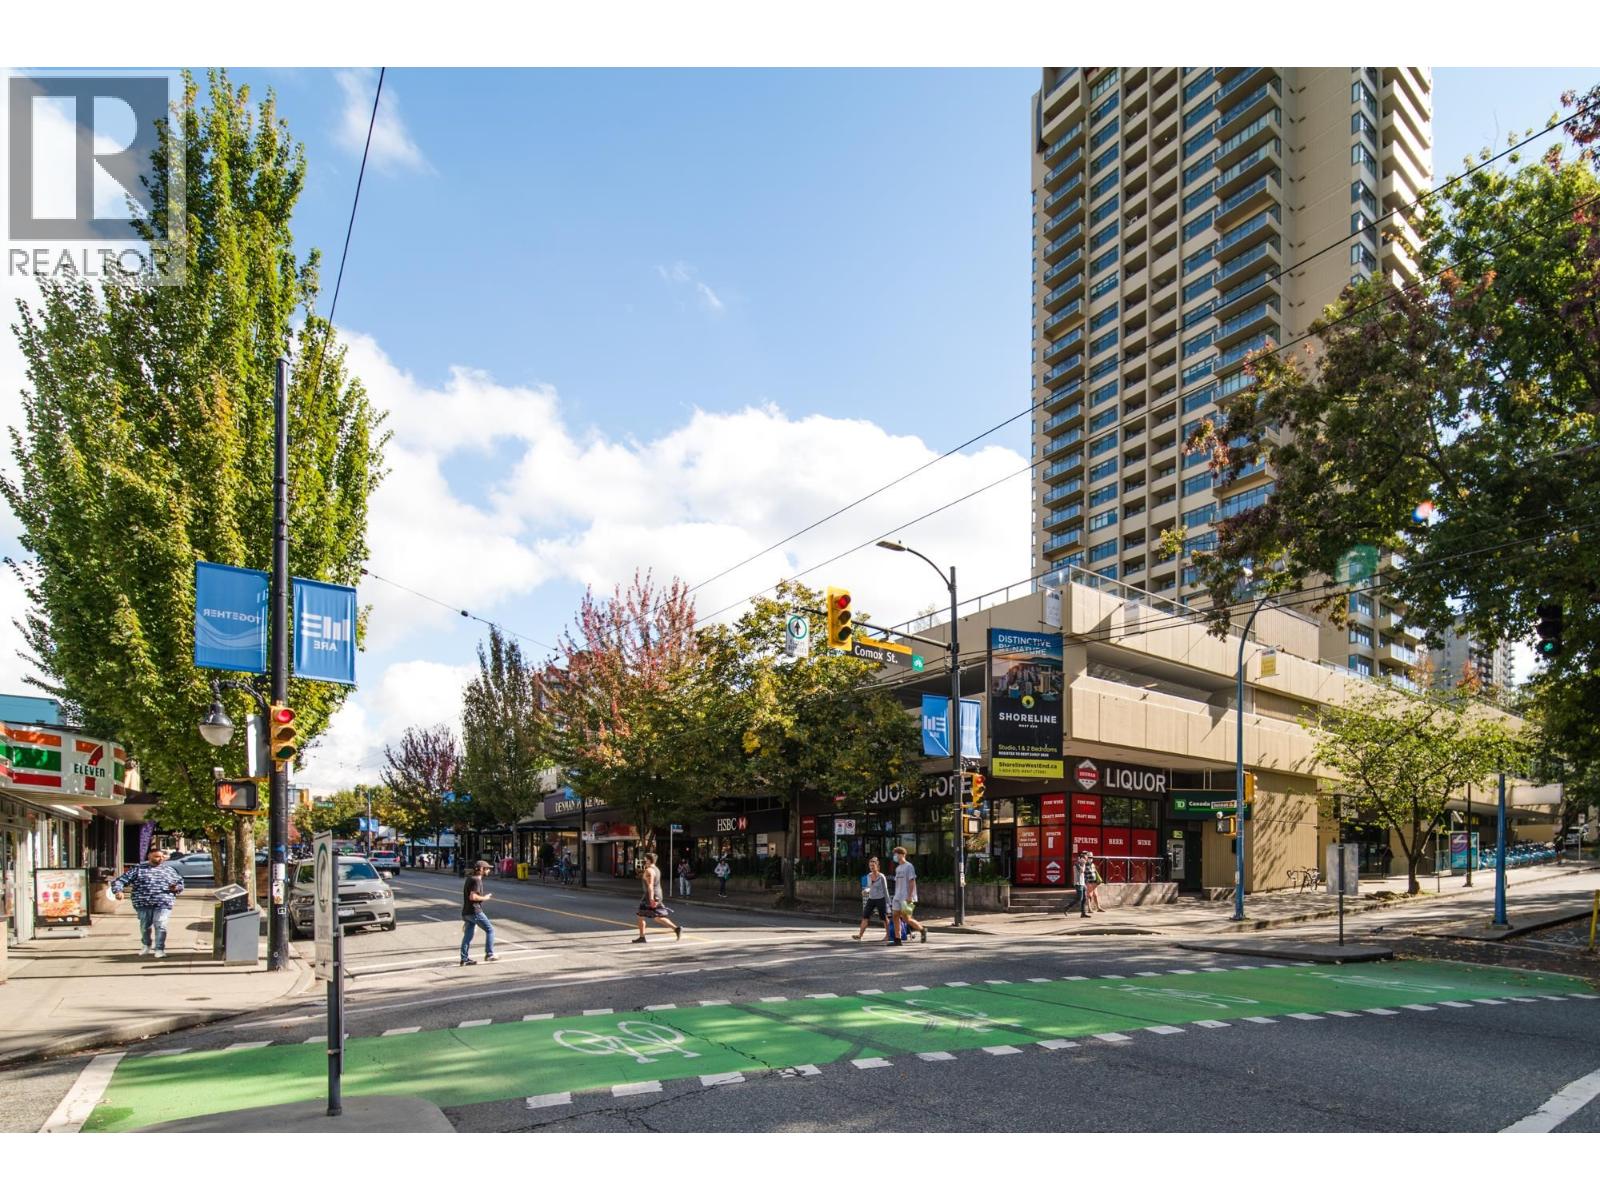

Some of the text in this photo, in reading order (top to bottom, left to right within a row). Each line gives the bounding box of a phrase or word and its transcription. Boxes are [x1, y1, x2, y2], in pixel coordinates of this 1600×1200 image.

[998, 634, 1051, 648] DISTINCTIVE
[854, 645, 899, 664] Comox St.
[998, 711, 1057, 724] SHORELINE
[75, 739, 104, 791] 7
[1106, 767, 1166, 793] LIQUOR
[1176, 800, 1185, 808] TD
[717, 816, 737, 832] HSBC
[1073, 836, 1099, 845] SPIRITS
[1108, 838, 1124, 846] BEER
